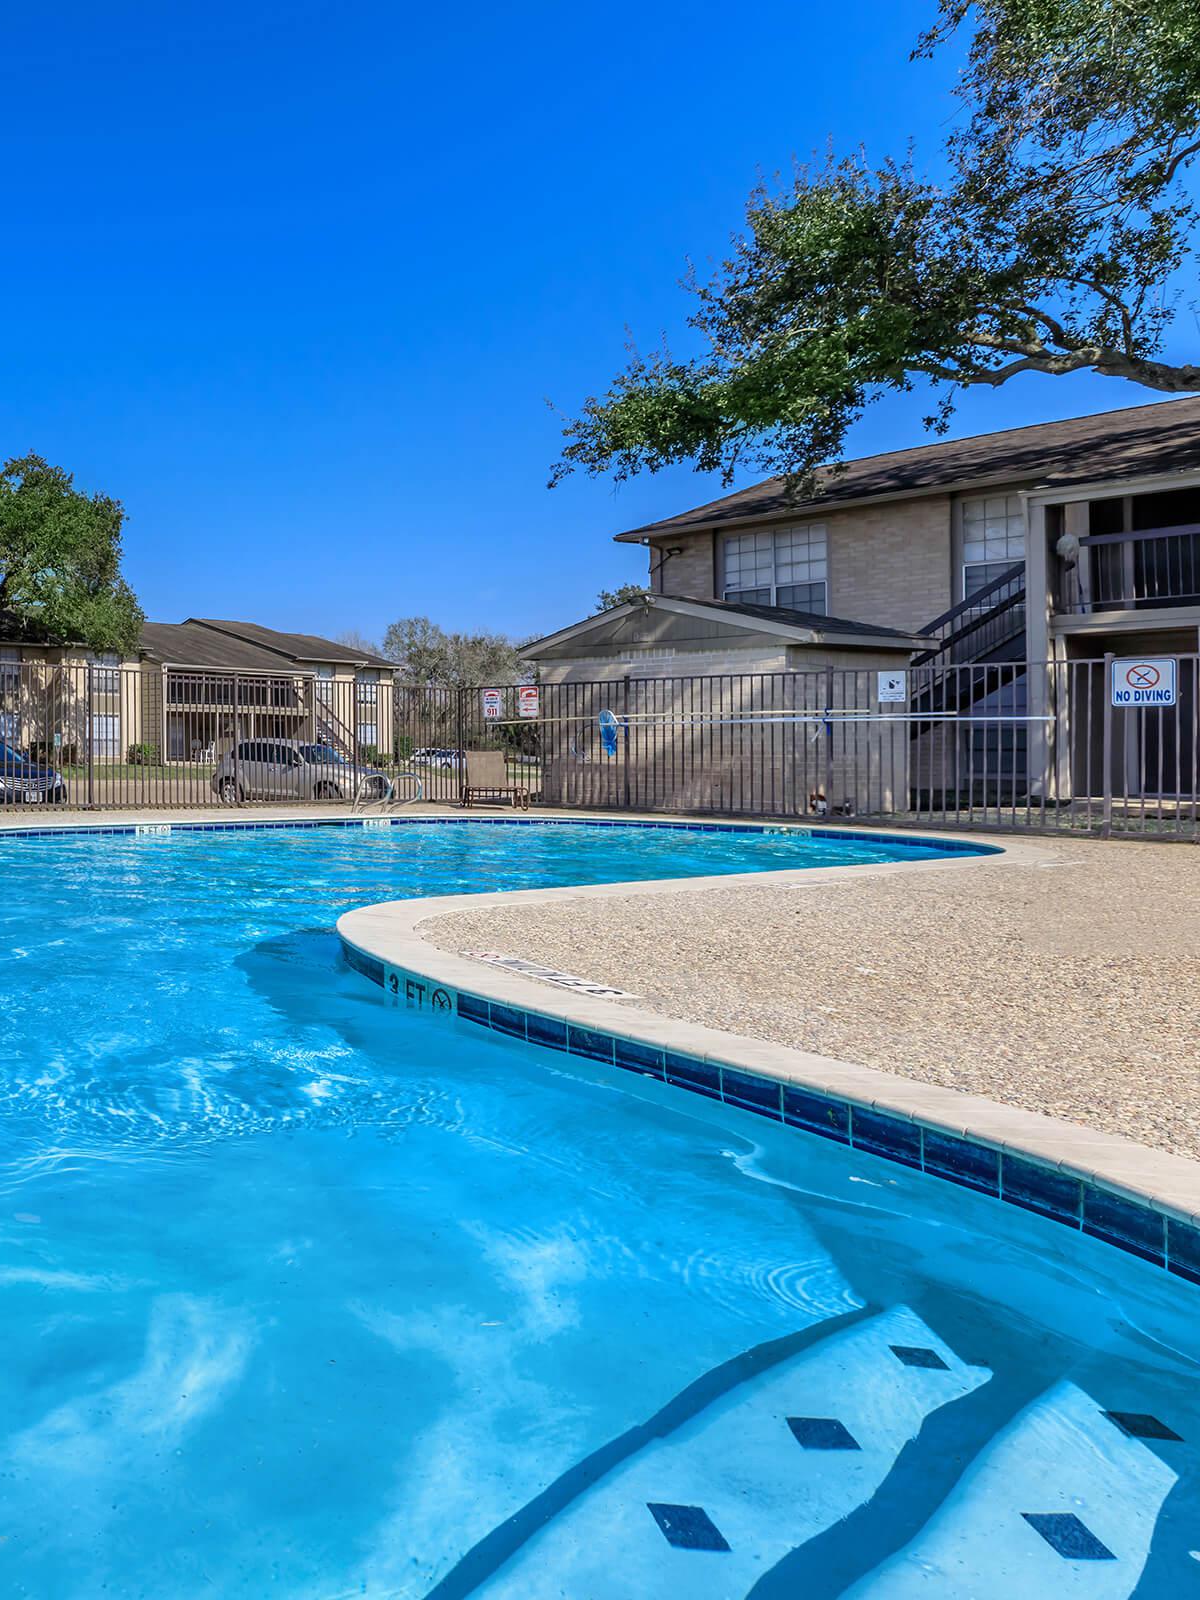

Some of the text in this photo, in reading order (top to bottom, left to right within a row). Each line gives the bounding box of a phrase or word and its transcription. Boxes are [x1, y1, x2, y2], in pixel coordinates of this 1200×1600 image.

[1116, 689, 1171, 702] NO DIVING
[487, 708, 497, 716] 911
[546, 977, 598, 987] FT
[406, 978, 426, 1004] FT
